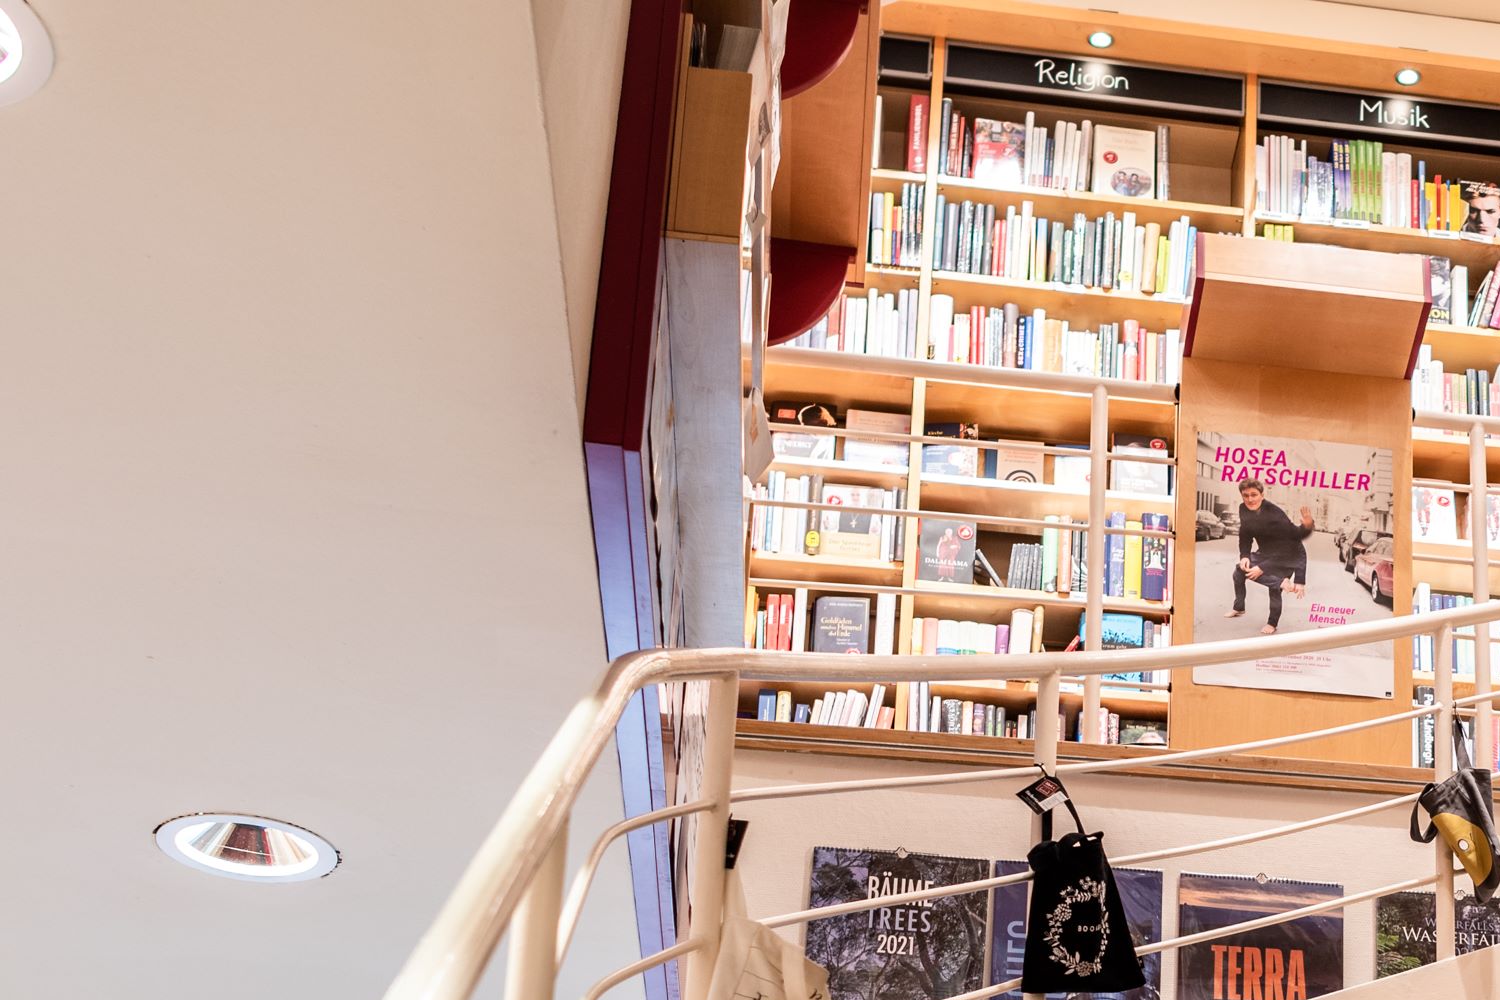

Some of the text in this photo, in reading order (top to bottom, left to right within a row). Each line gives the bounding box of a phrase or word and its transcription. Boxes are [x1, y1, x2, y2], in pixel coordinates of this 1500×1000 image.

[1035, 59, 1129, 92] Religion
[1359, 99, 1430, 129] Musik
[1215, 446, 1287, 467] HOSEA
[1221, 464, 1372, 492] RATSCHILLER
[948, 558, 969, 568] LAMA
[1308, 614, 1347, 626] Mensch
[1310, 604, 1357, 616] Ein neuer
[1420, 719, 1435, 764] Lindbergh
[867, 871, 936, 909] BÄUME
[868, 906, 932, 934] TREES
[876, 934, 915, 956] 2021
